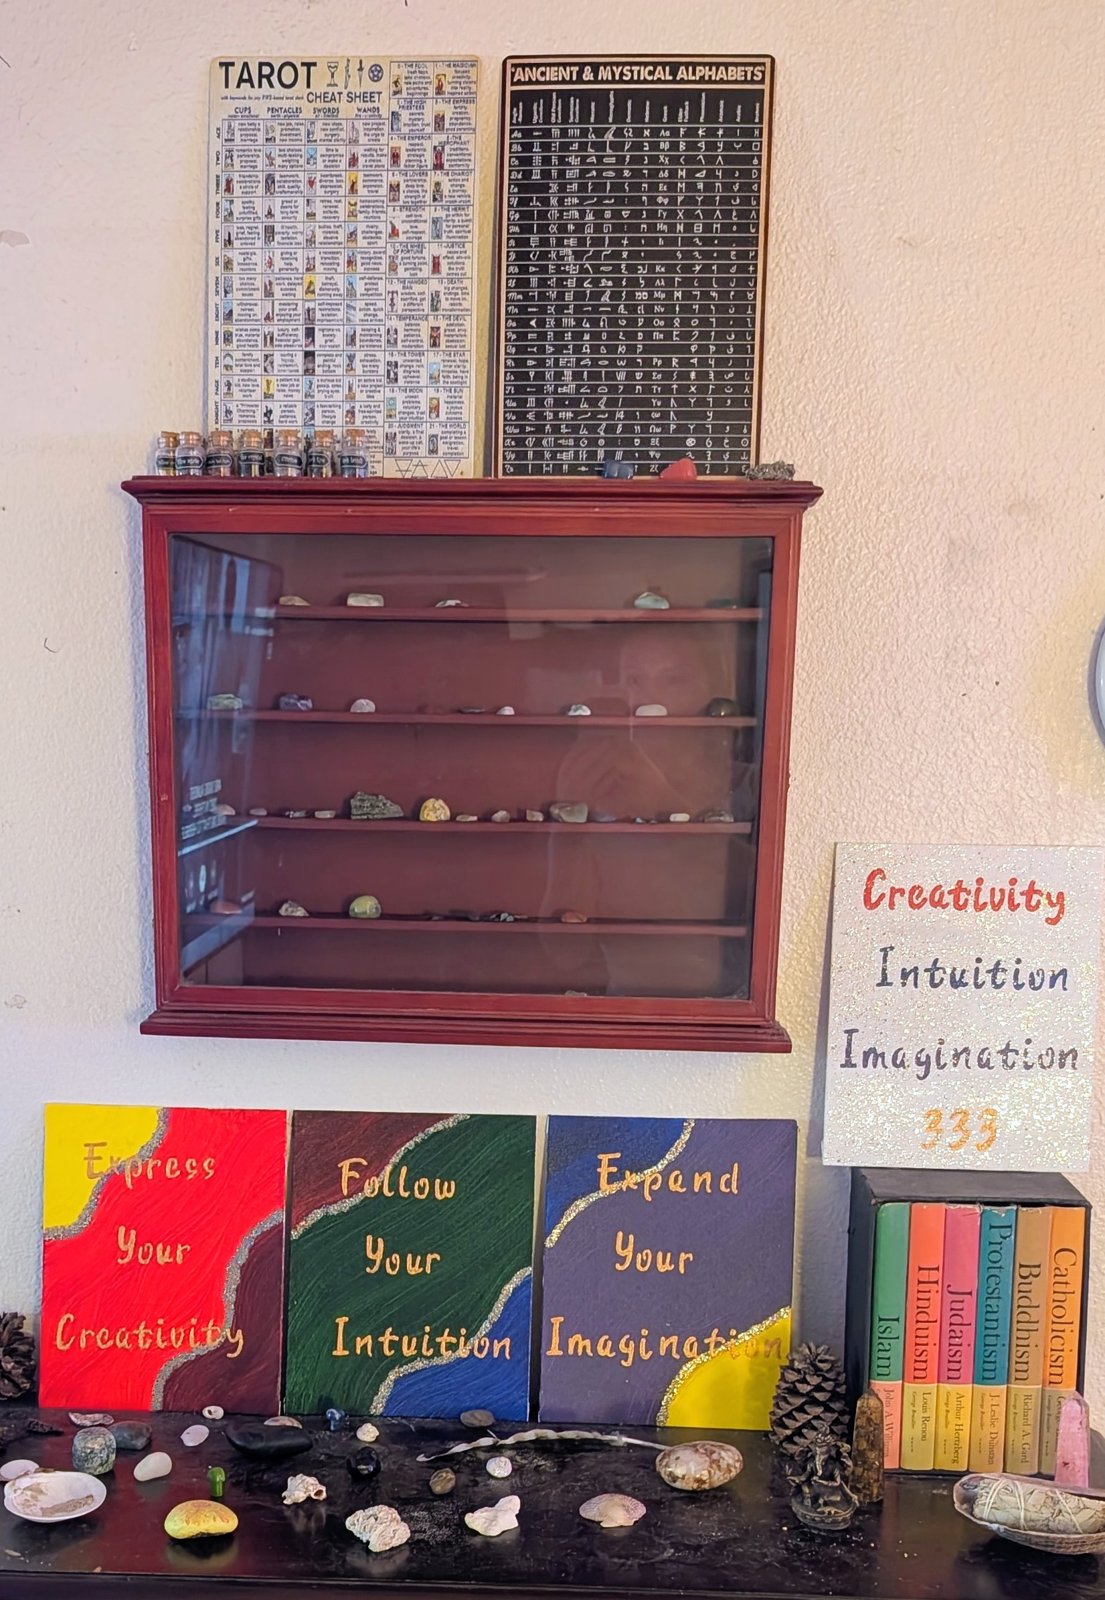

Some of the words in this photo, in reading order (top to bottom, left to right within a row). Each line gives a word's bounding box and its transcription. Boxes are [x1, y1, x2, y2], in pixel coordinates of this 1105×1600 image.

[219, 61, 317, 89] TAROT
[514, 66, 579, 82] ANCIENT
[582, 66, 594, 80] &
[598, 66, 672, 80] MYSTICAL
[676, 66, 762, 80] ALPHABETS
[306, 92, 343, 103] CHEAT
[346, 92, 382, 103] SHEET
[863, 868, 1065, 925] Creativity
[876, 944, 1068, 991] Intuition
[840, 1028, 1079, 1081] Imagination
[920, 1108, 998, 1152] 333
[83, 1141, 216, 1189] Express
[338, 1158, 456, 1200] Follow
[597, 1152, 740, 1201] Expand
[117, 1225, 190, 1265] Your
[366, 1234, 440, 1275] Your
[614, 1231, 694, 1274] Your
[913, 1265, 940, 1381] Hinduism
[982, 1223, 1012, 1382] Protestantism
[1014, 1263, 1041, 1382] Buddhism
[1048, 1248, 1078, 1386] Catholicism
[56, 1313, 243, 1358] Creativity
[331, 1316, 511, 1360] Intuition
[546, 1317, 783, 1367] Imagination
[877, 1315, 900, 1378] Islam
[947, 1284, 972, 1381] Judaism
[884, 1388, 894, 1408] John
[922, 1392, 932, 1412] Louis
[955, 1392, 966, 1420] Arthur
[988, 1392, 1000, 1400] J.
[988, 1402, 1000, 1426] Leslie
[1022, 1394, 1033, 1428] Richard
[921, 1414, 932, 1442] Renou
[952, 1422, 964, 1465] Hertzberg
[988, 1428, 999, 1465] Dunstan
[1022, 1429, 1032, 1440] A.
[1020, 1440, 1031, 1464] Gard
